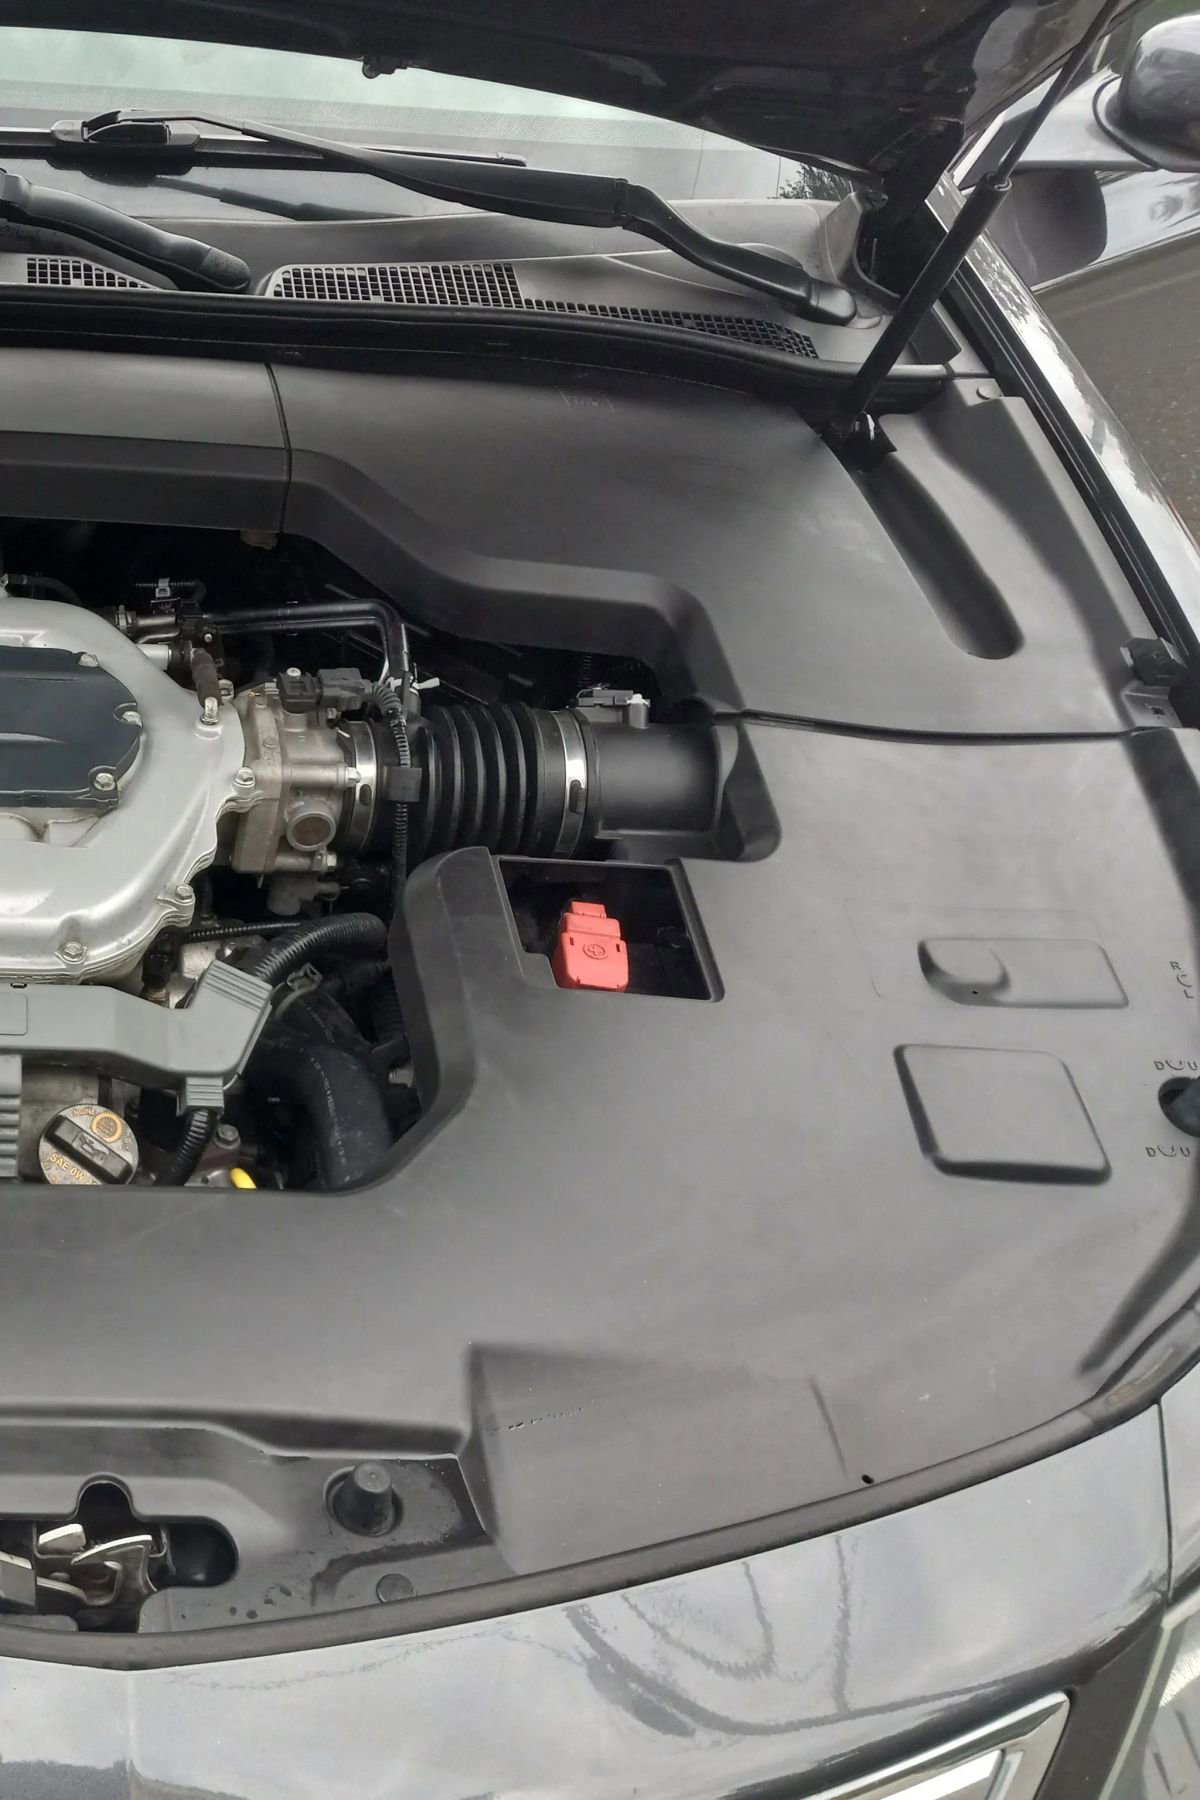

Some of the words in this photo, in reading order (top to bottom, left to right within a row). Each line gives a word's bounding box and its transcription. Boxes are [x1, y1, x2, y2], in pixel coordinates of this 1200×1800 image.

[1170, 961, 1181, 970] R
[69, 1107, 96, 1117] ENGINE
[50, 1153, 71, 1171] SAE
